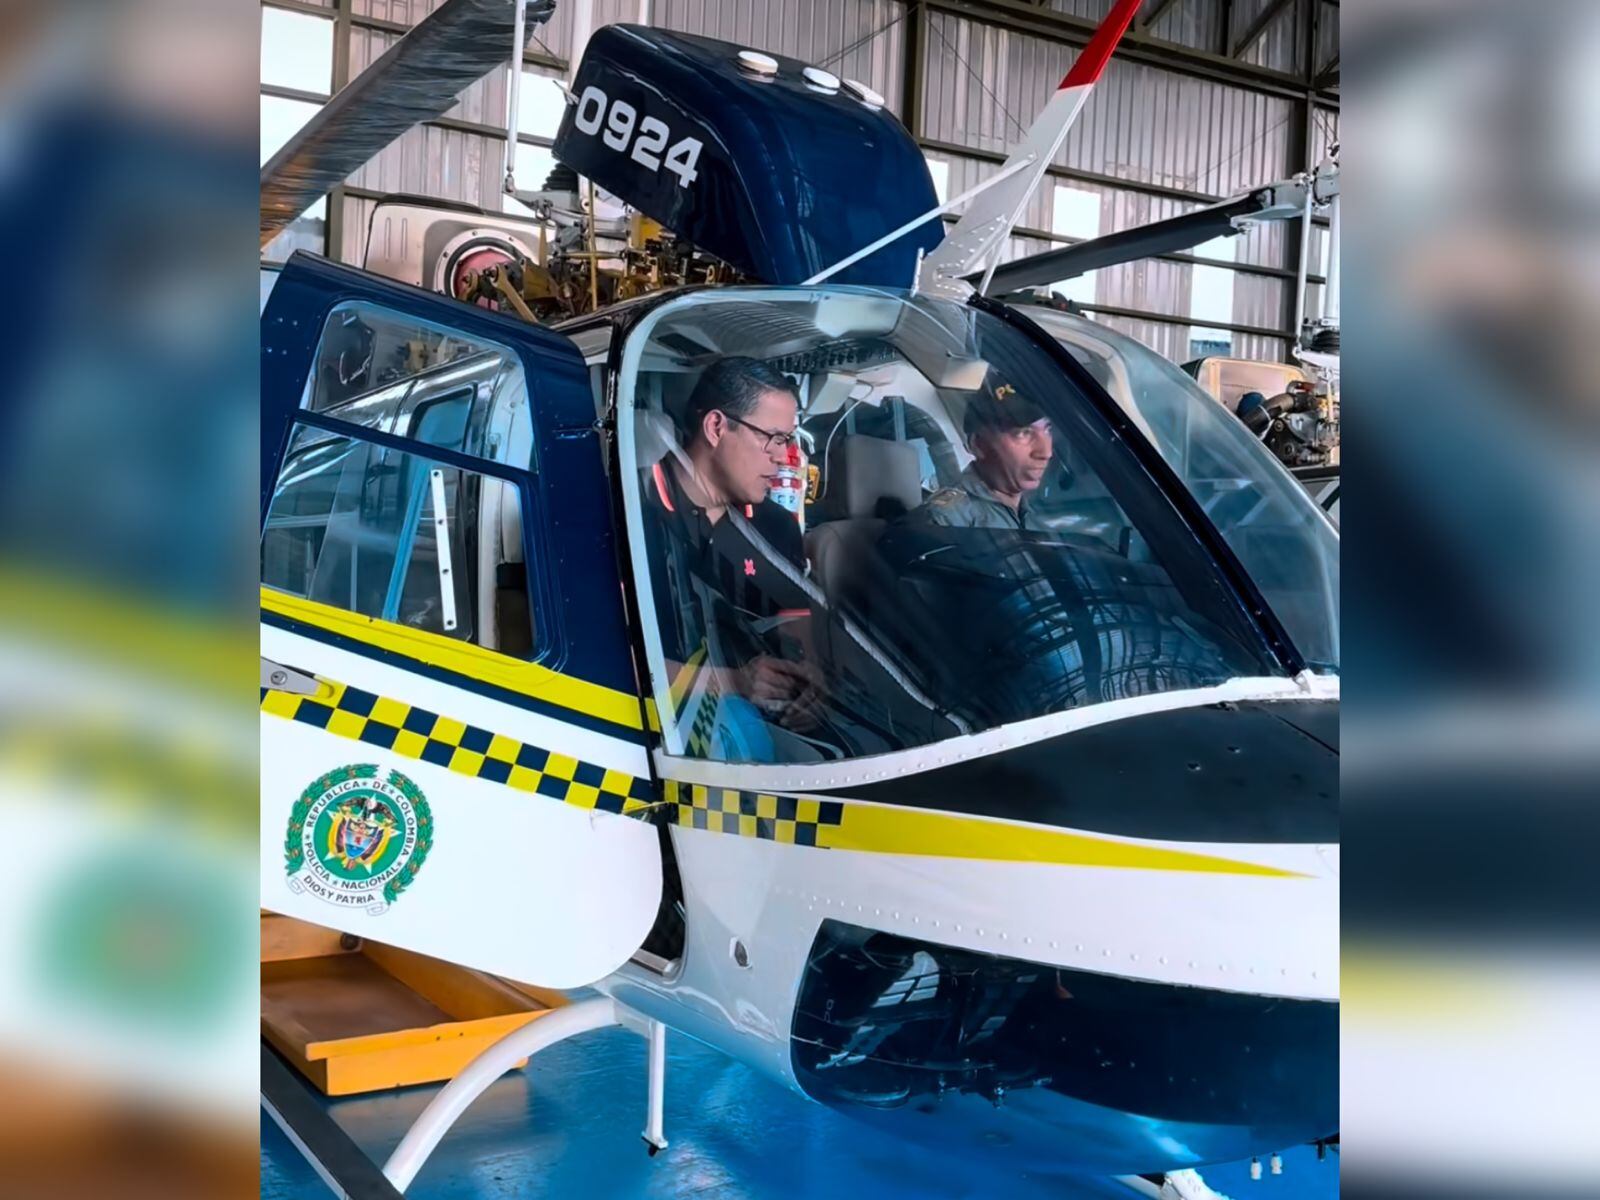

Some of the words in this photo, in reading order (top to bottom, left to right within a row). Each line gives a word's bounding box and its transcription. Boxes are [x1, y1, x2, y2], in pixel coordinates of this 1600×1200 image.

[575, 85, 703, 189] 0924
[372, 780, 389, 792] DE
[395, 795, 415, 857] COLOMBIA
[303, 875, 326, 896] DIOS
[326, 890, 335, 900] Y
[335, 893, 376, 904] PATRIA
[341, 866, 399, 890] NACIONAL
